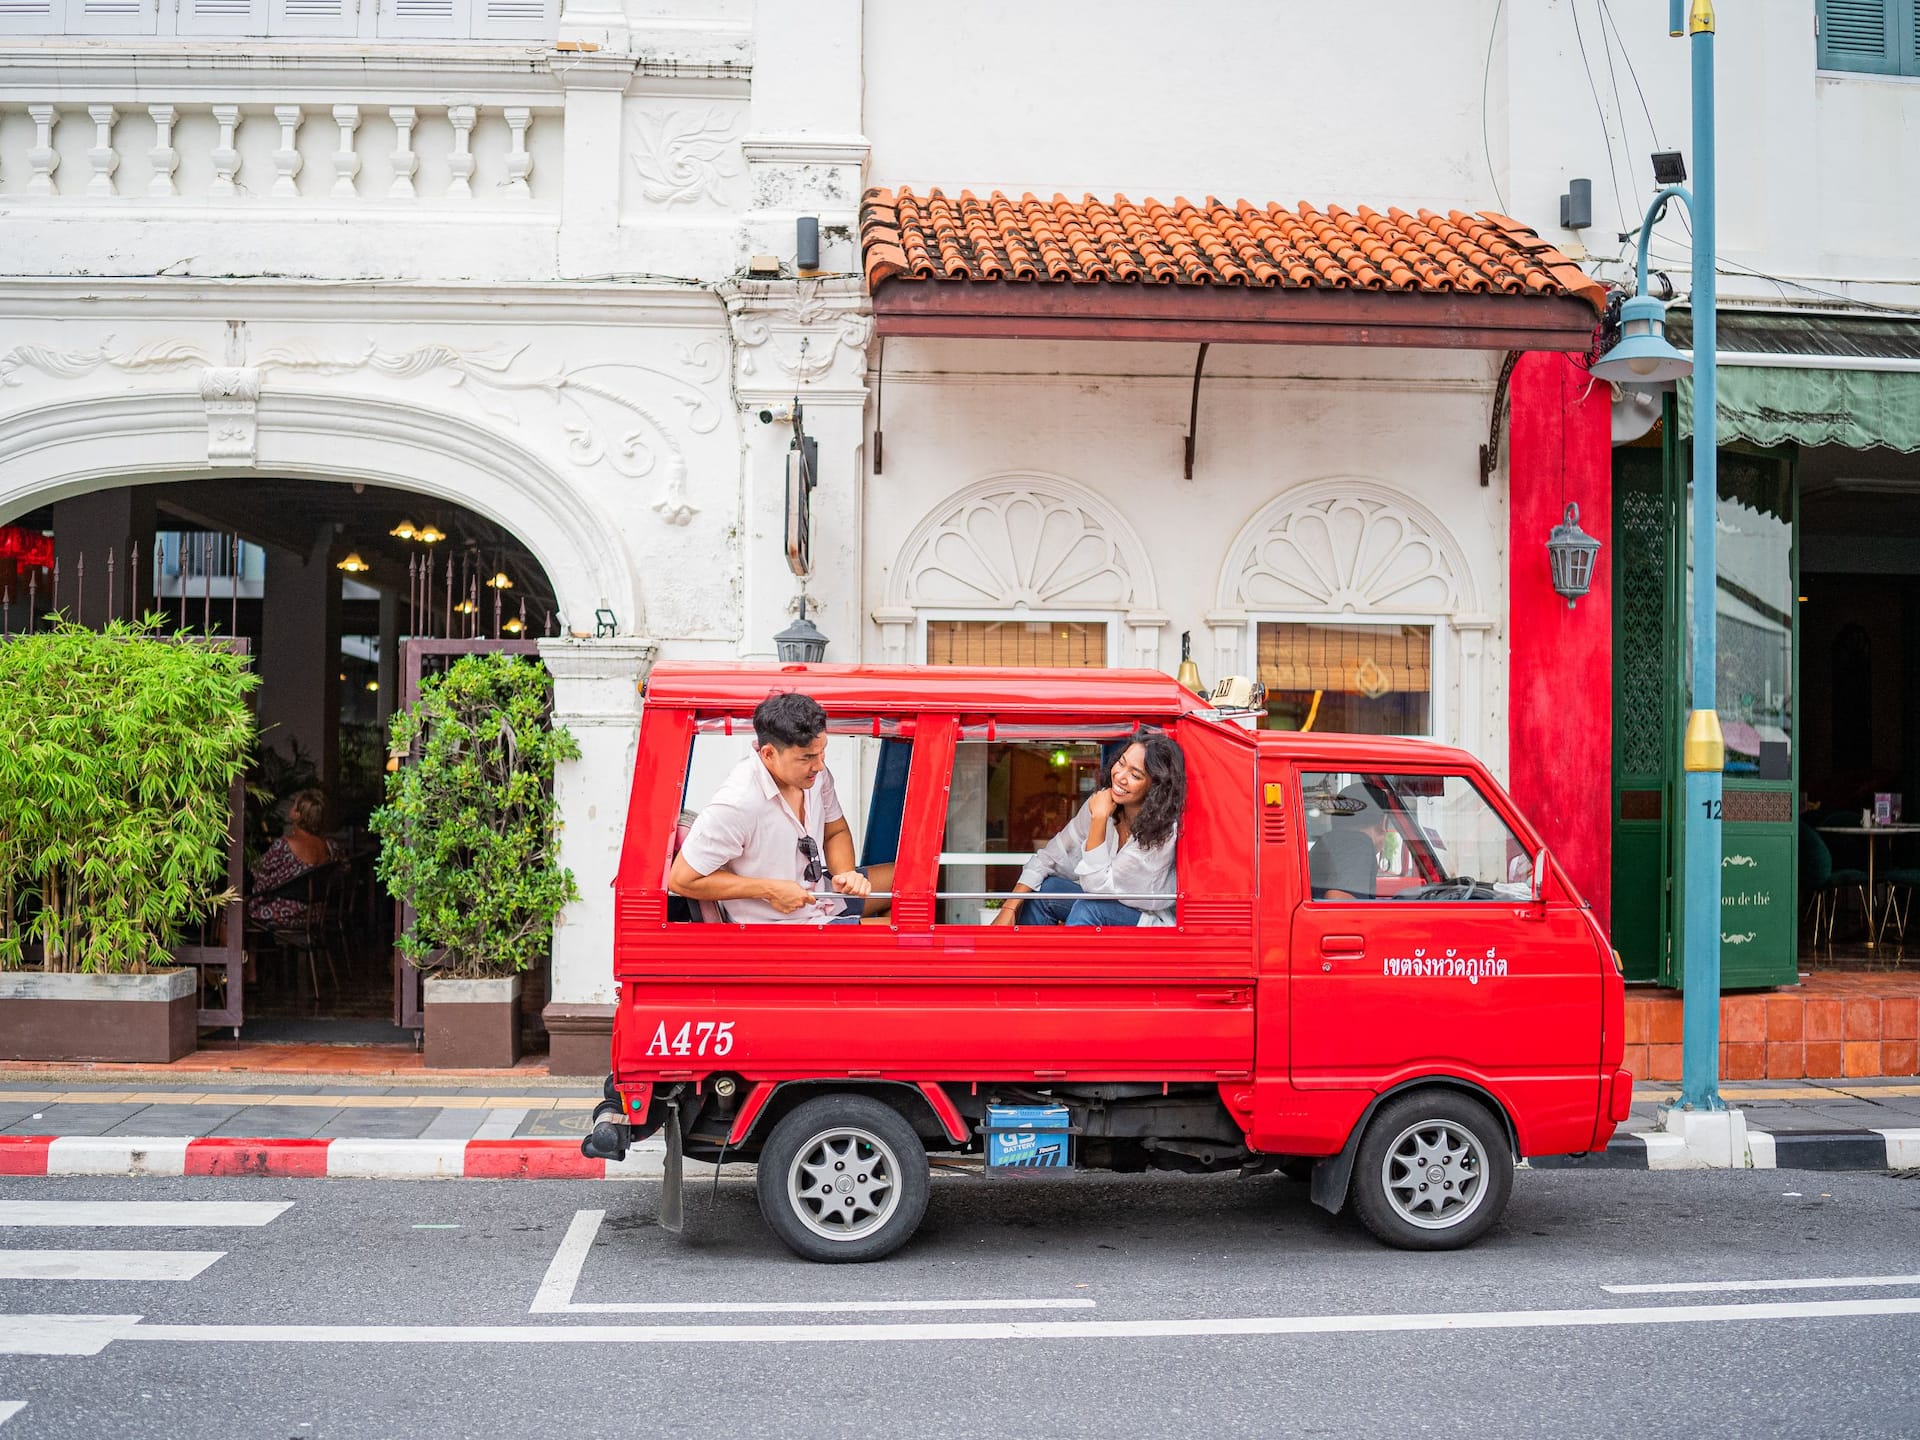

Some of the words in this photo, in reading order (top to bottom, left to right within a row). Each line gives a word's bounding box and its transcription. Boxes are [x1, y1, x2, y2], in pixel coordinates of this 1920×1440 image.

[1721, 896, 1735, 906] on
[1737, 891, 1751, 906] de
[1753, 891, 1770, 906] thé
[1383, 946, 1508, 985] เขตจังหวัดภูเก็ต
[645, 1019, 736, 1057] A475
[998, 1122, 1036, 1147] GS
[1003, 1142, 1036, 1154] BATTERY
